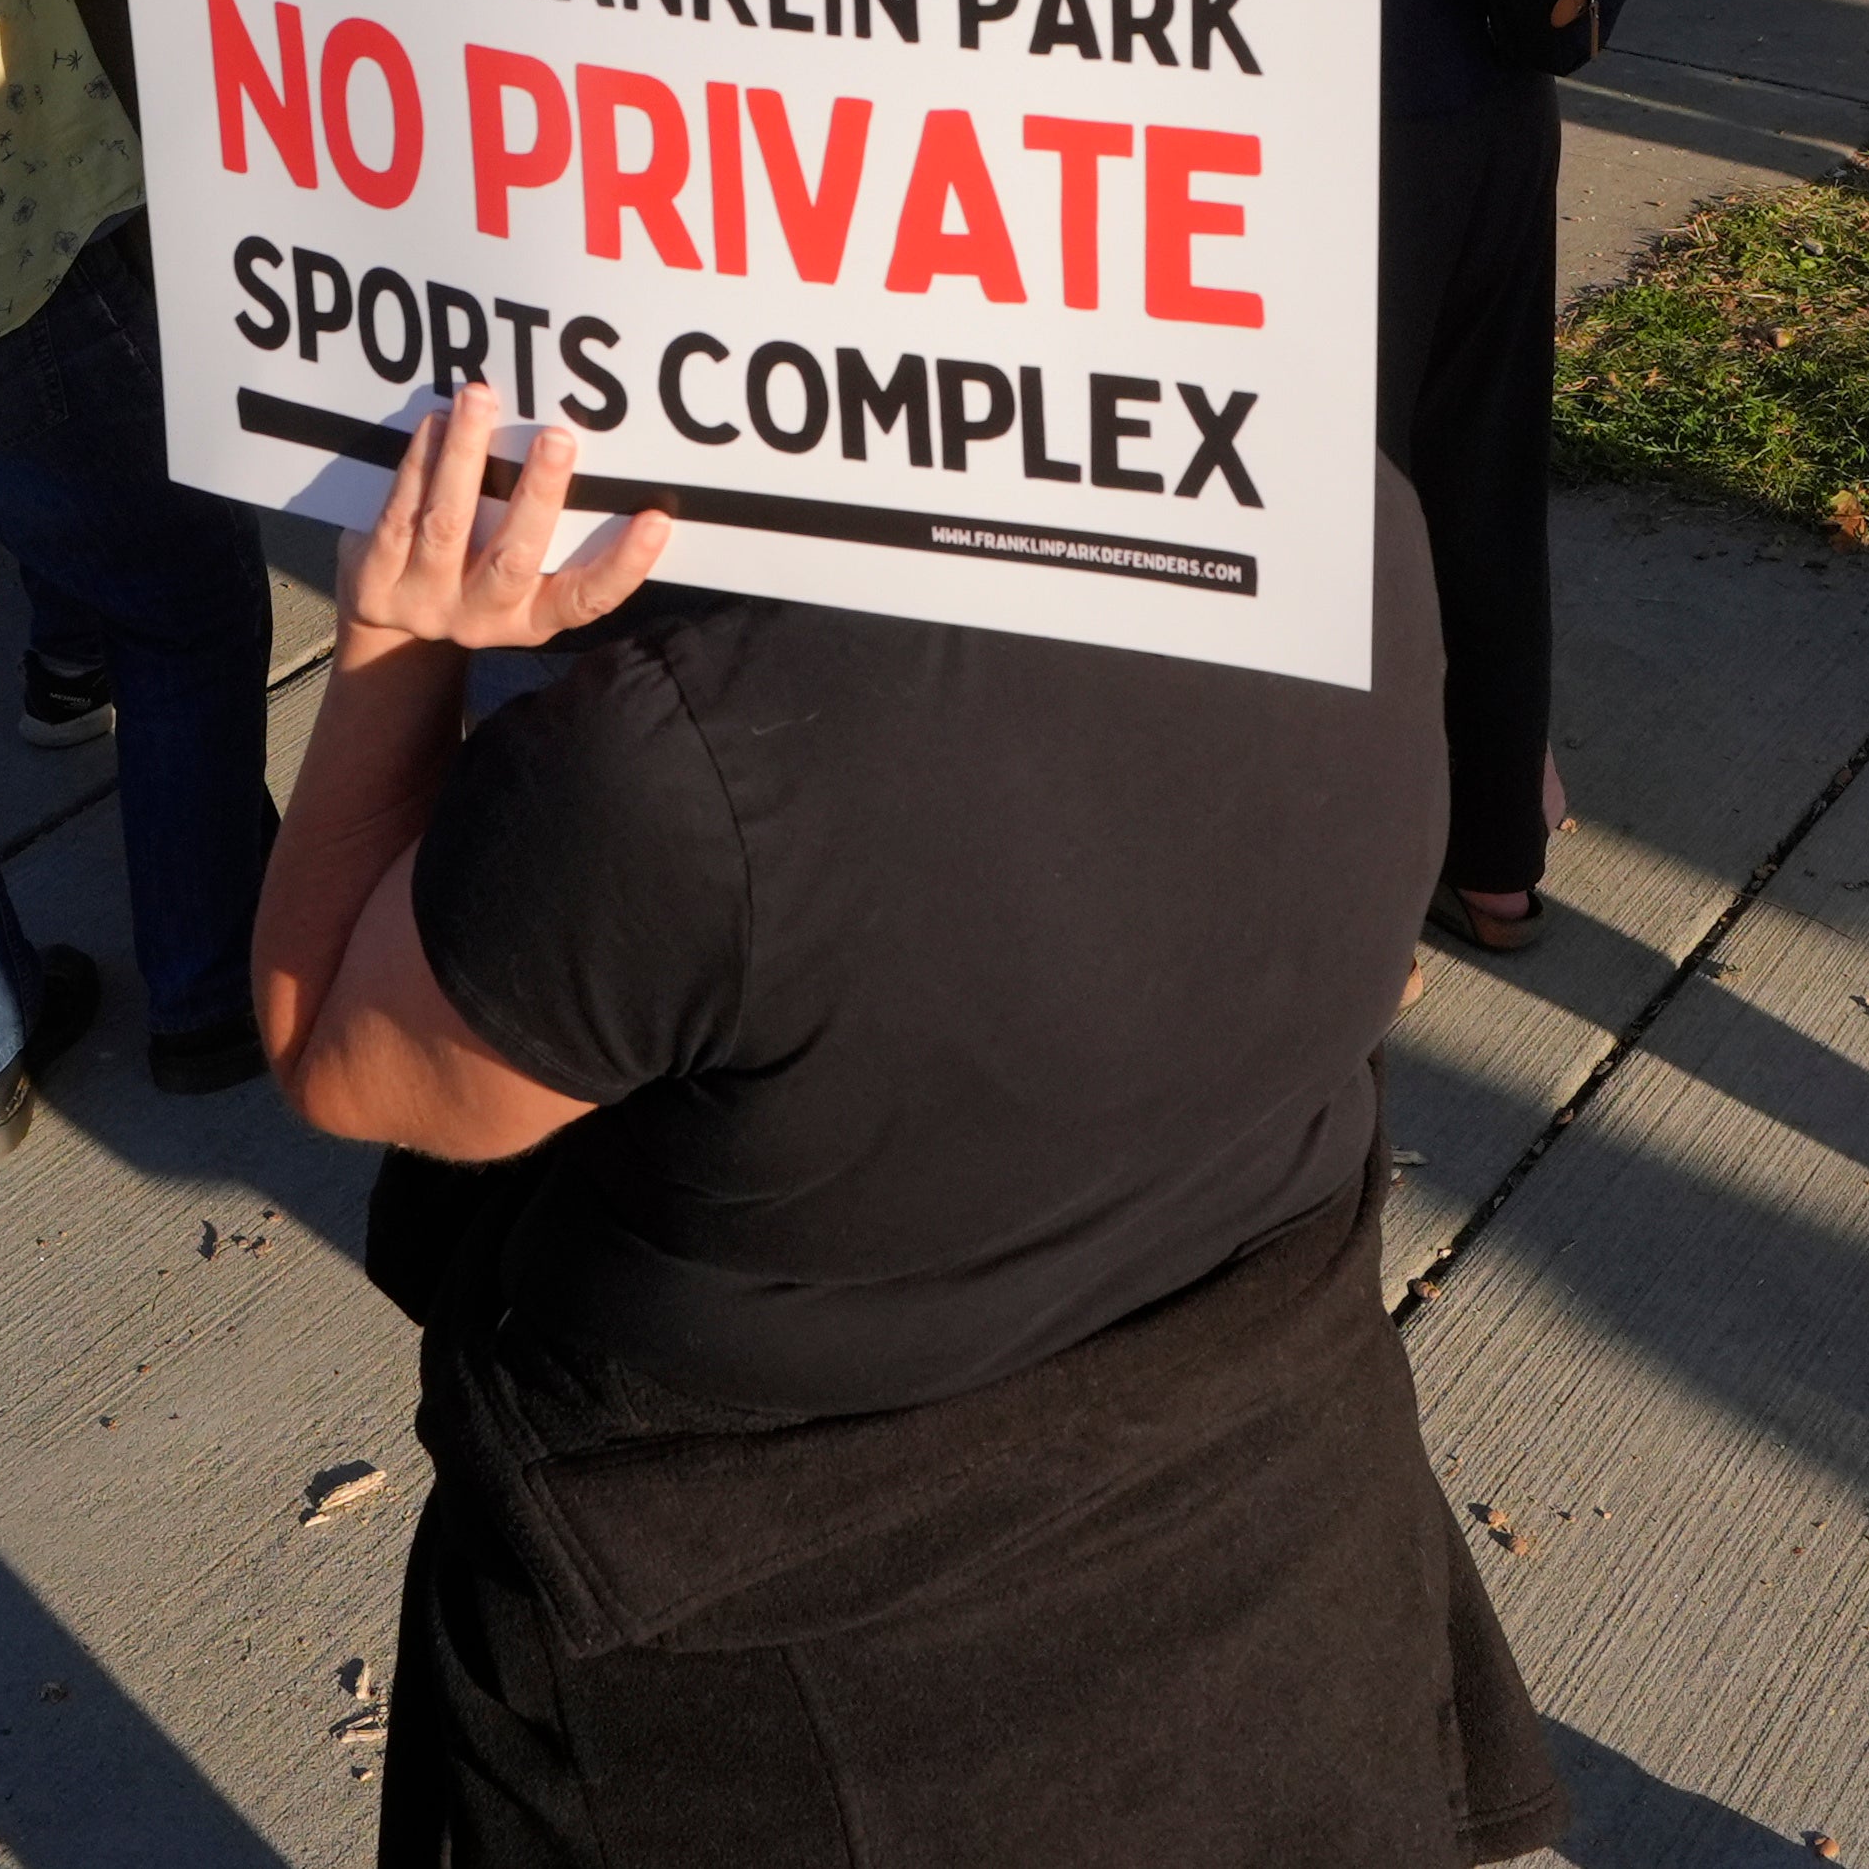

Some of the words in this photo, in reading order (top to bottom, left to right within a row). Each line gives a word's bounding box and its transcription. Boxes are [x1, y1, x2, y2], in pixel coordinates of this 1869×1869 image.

[464, 43, 1265, 328] PRIVATE
[232, 236, 627, 431] SPORTS
[658, 332, 1264, 509] COMPLEX
[931, 525, 1242, 584] WWW.FRANKLINPARKDEFENDERS.COM
